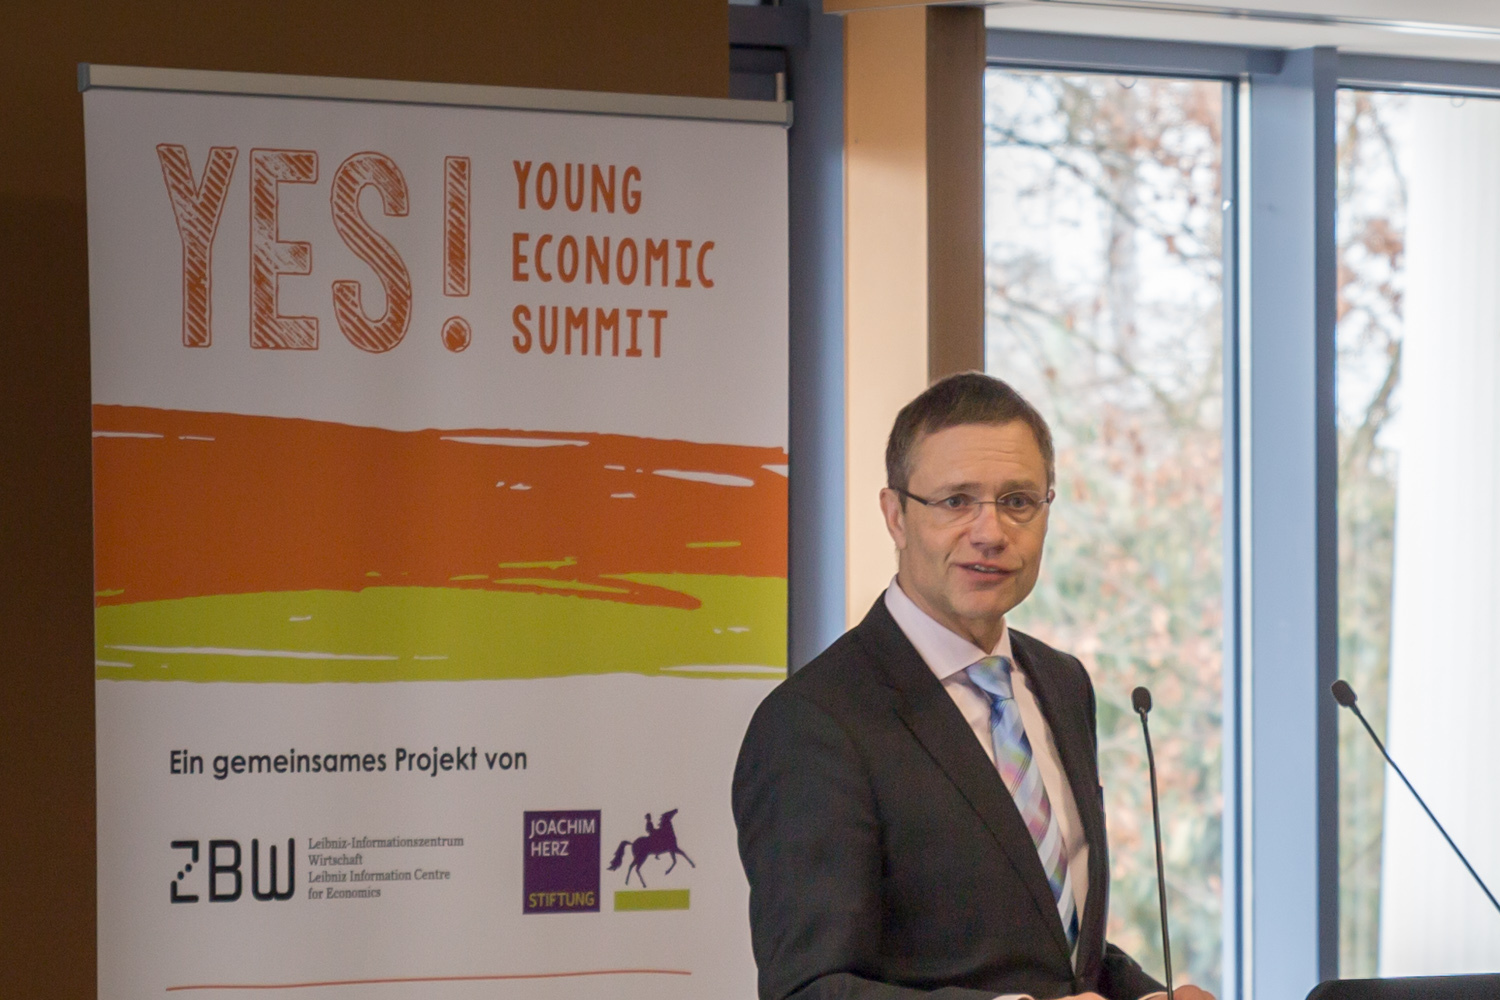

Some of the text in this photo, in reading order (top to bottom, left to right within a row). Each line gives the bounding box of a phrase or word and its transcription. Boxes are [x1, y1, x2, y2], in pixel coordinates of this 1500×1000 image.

[512, 159, 643, 215] YOUNG
[156, 142, 472, 354] YES!
[512, 232, 716, 289] ECONOMIC
[512, 304, 669, 358] SUMMIT
[170, 747, 528, 780] Ein gemeinsames Projekt von
[529, 818, 596, 839] JOACHIM
[308, 836, 464, 850] Leibniz-Informationszentrum
[531, 841, 569, 857] HERZ
[170, 837, 296, 903] ZBW
[308, 853, 363, 866] Wirtschaft
[308, 868, 451, 883] Leibniz Information Centre
[308, 886, 381, 900] for Economics
[529, 891, 595, 907] STIFTUNG
